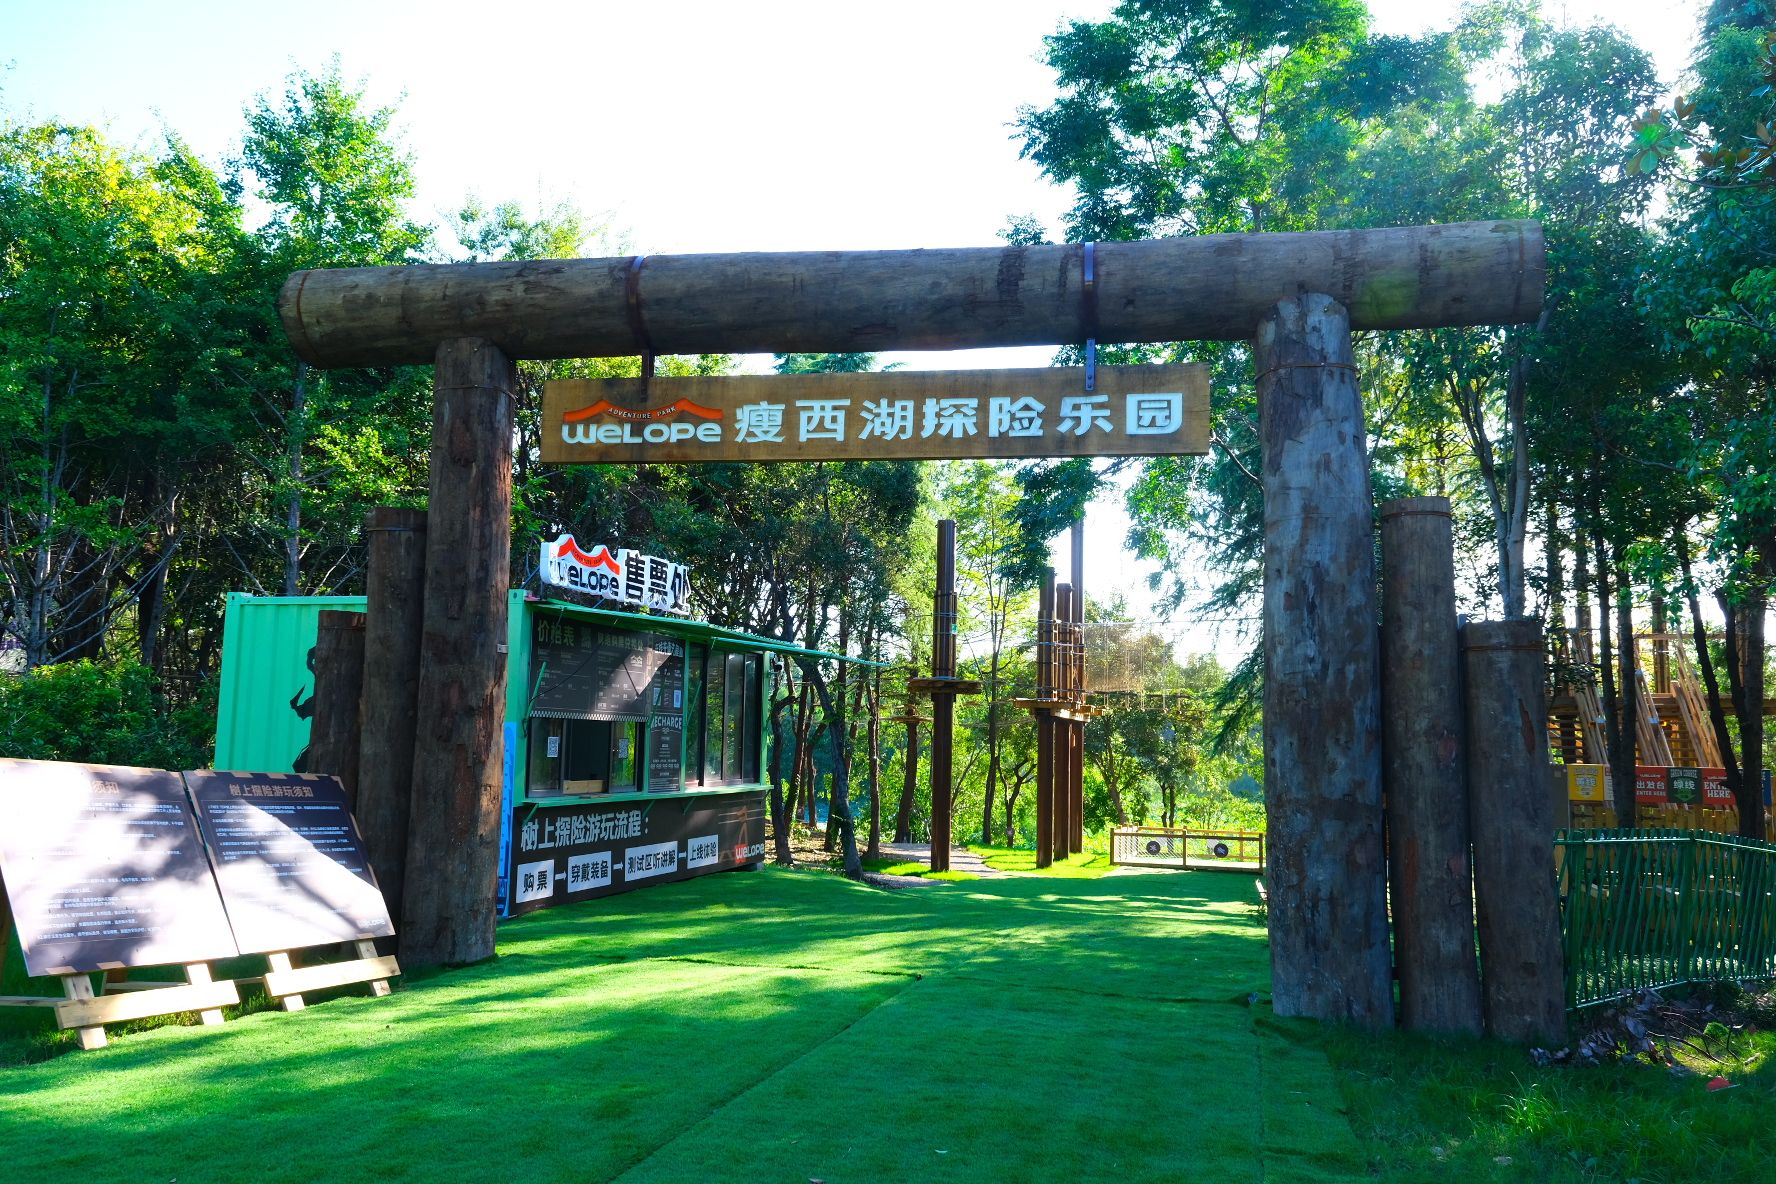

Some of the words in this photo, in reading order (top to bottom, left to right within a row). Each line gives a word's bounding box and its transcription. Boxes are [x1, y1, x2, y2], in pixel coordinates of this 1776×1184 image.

[608, 407, 652, 419] ADVENTURE
[656, 406, 676, 417] PARK
[733, 391, 1185, 444] 瘦西湖探险乐园
[625, 550, 692, 611] 售票处
[537, 618, 576, 647] 价格表
[229, 783, 314, 798] 树上探险游玩须知
[1636, 780, 1665, 789] 出发台
[1673, 779, 1696, 790] 绿线
[1707, 790, 1731, 798] HERE
[627, 846, 676, 875] 测试区听讲解
[689, 841, 717, 861] 上线体验
[571, 860, 609, 884] 穿戴装备
